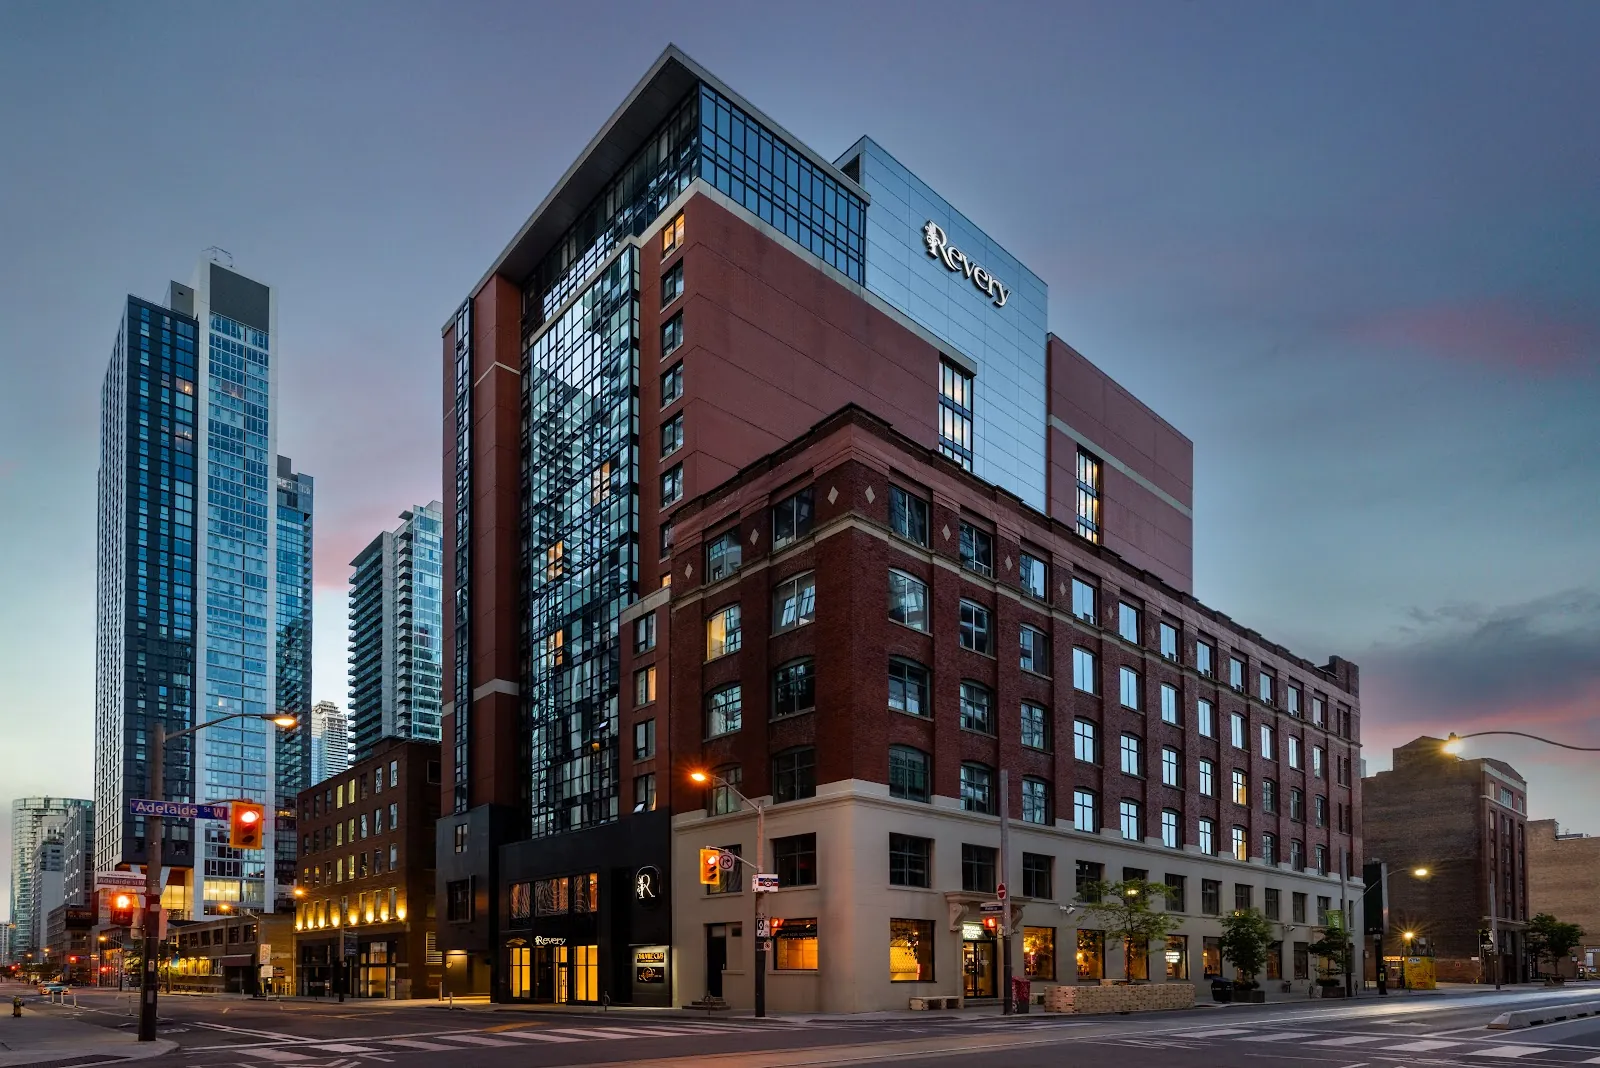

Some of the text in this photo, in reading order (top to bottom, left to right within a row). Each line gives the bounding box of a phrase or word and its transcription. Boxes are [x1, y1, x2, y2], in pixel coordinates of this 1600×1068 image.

[924, 220, 1012, 307] Revery
[135, 801, 198, 816] Adelaide
[213, 807, 224, 818] W
[535, 935, 566, 946] Revery
